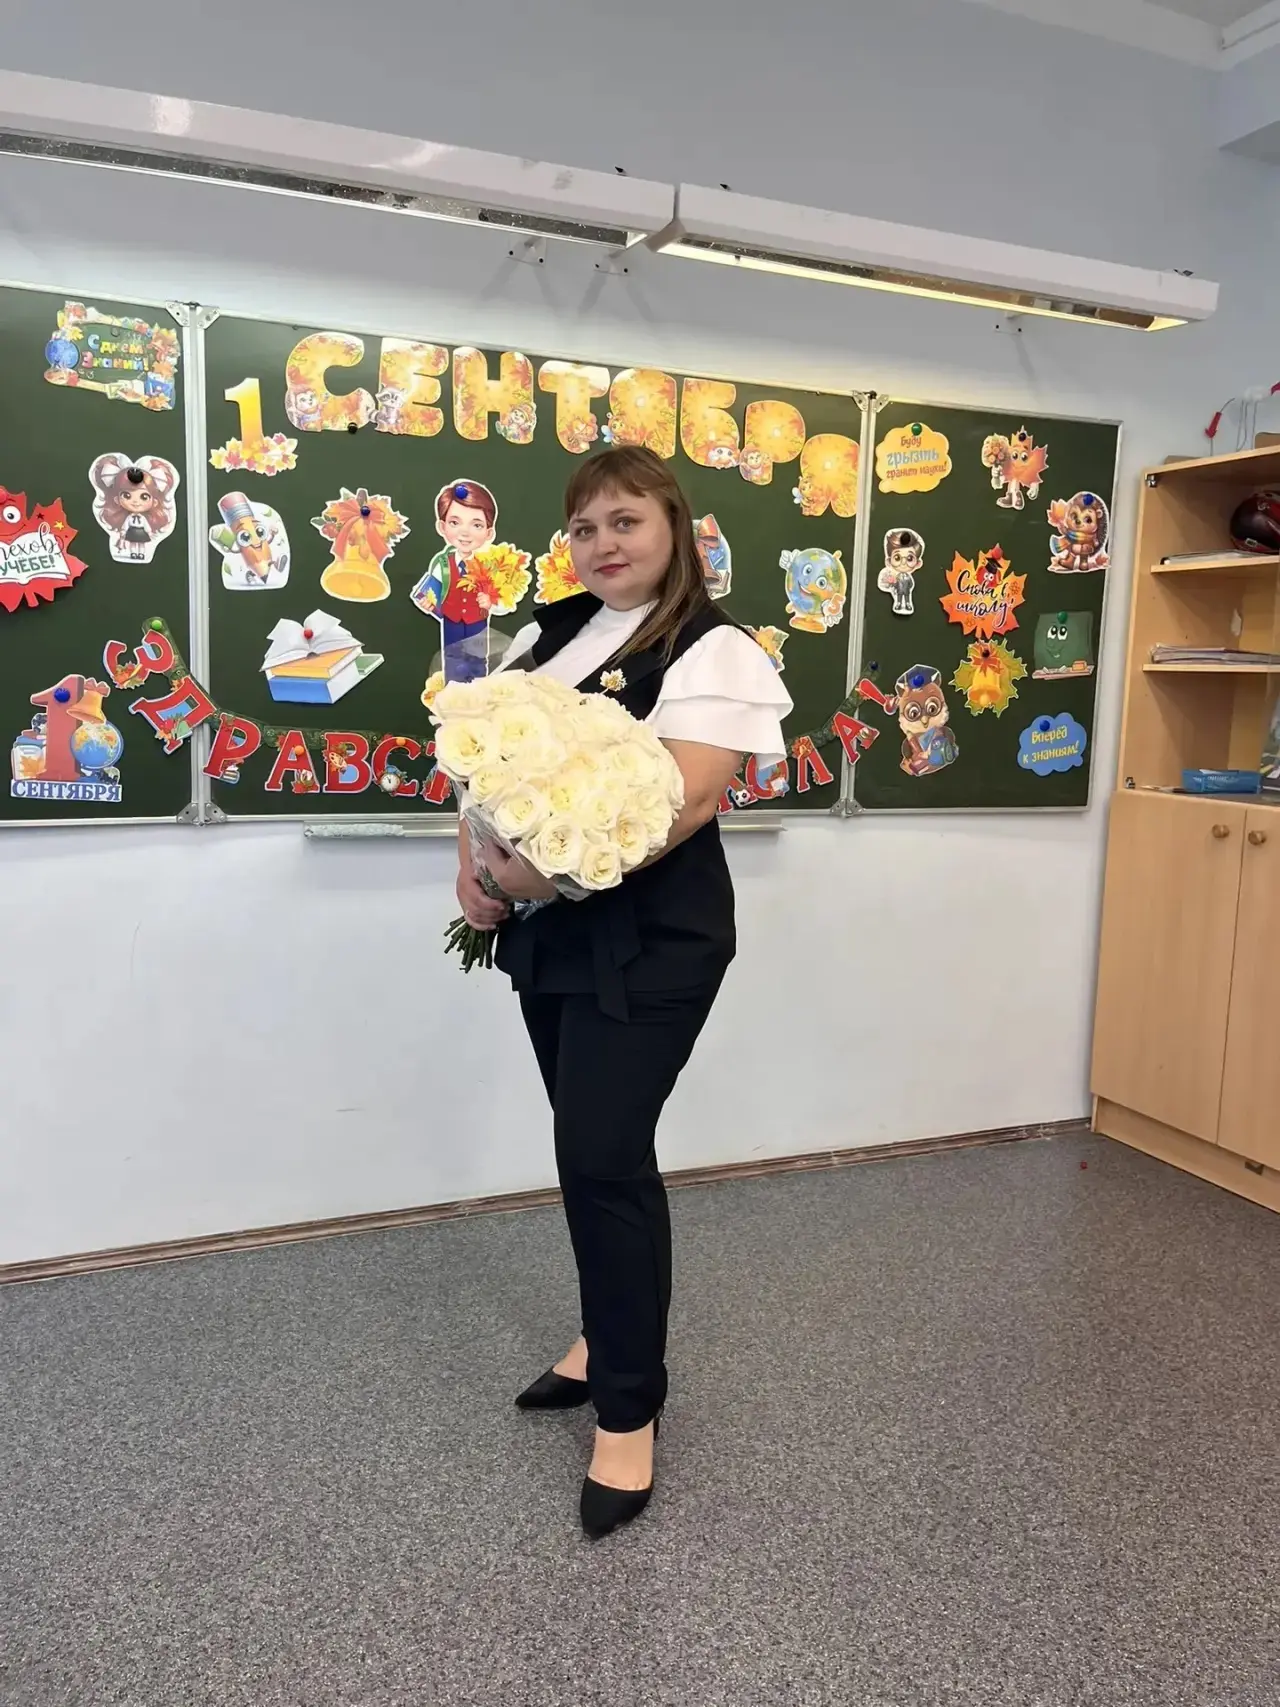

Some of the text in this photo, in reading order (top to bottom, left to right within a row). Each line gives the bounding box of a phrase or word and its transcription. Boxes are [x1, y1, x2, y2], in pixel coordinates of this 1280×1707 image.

[87, 334, 100, 350] С
[224, 331, 860, 517] 1 СЕНТЯБРЯ
[957, 569, 998, 599] Снова
[957, 598, 1014, 628] школу!
[12, 781, 121, 801] СЕНТЯБРЯ
